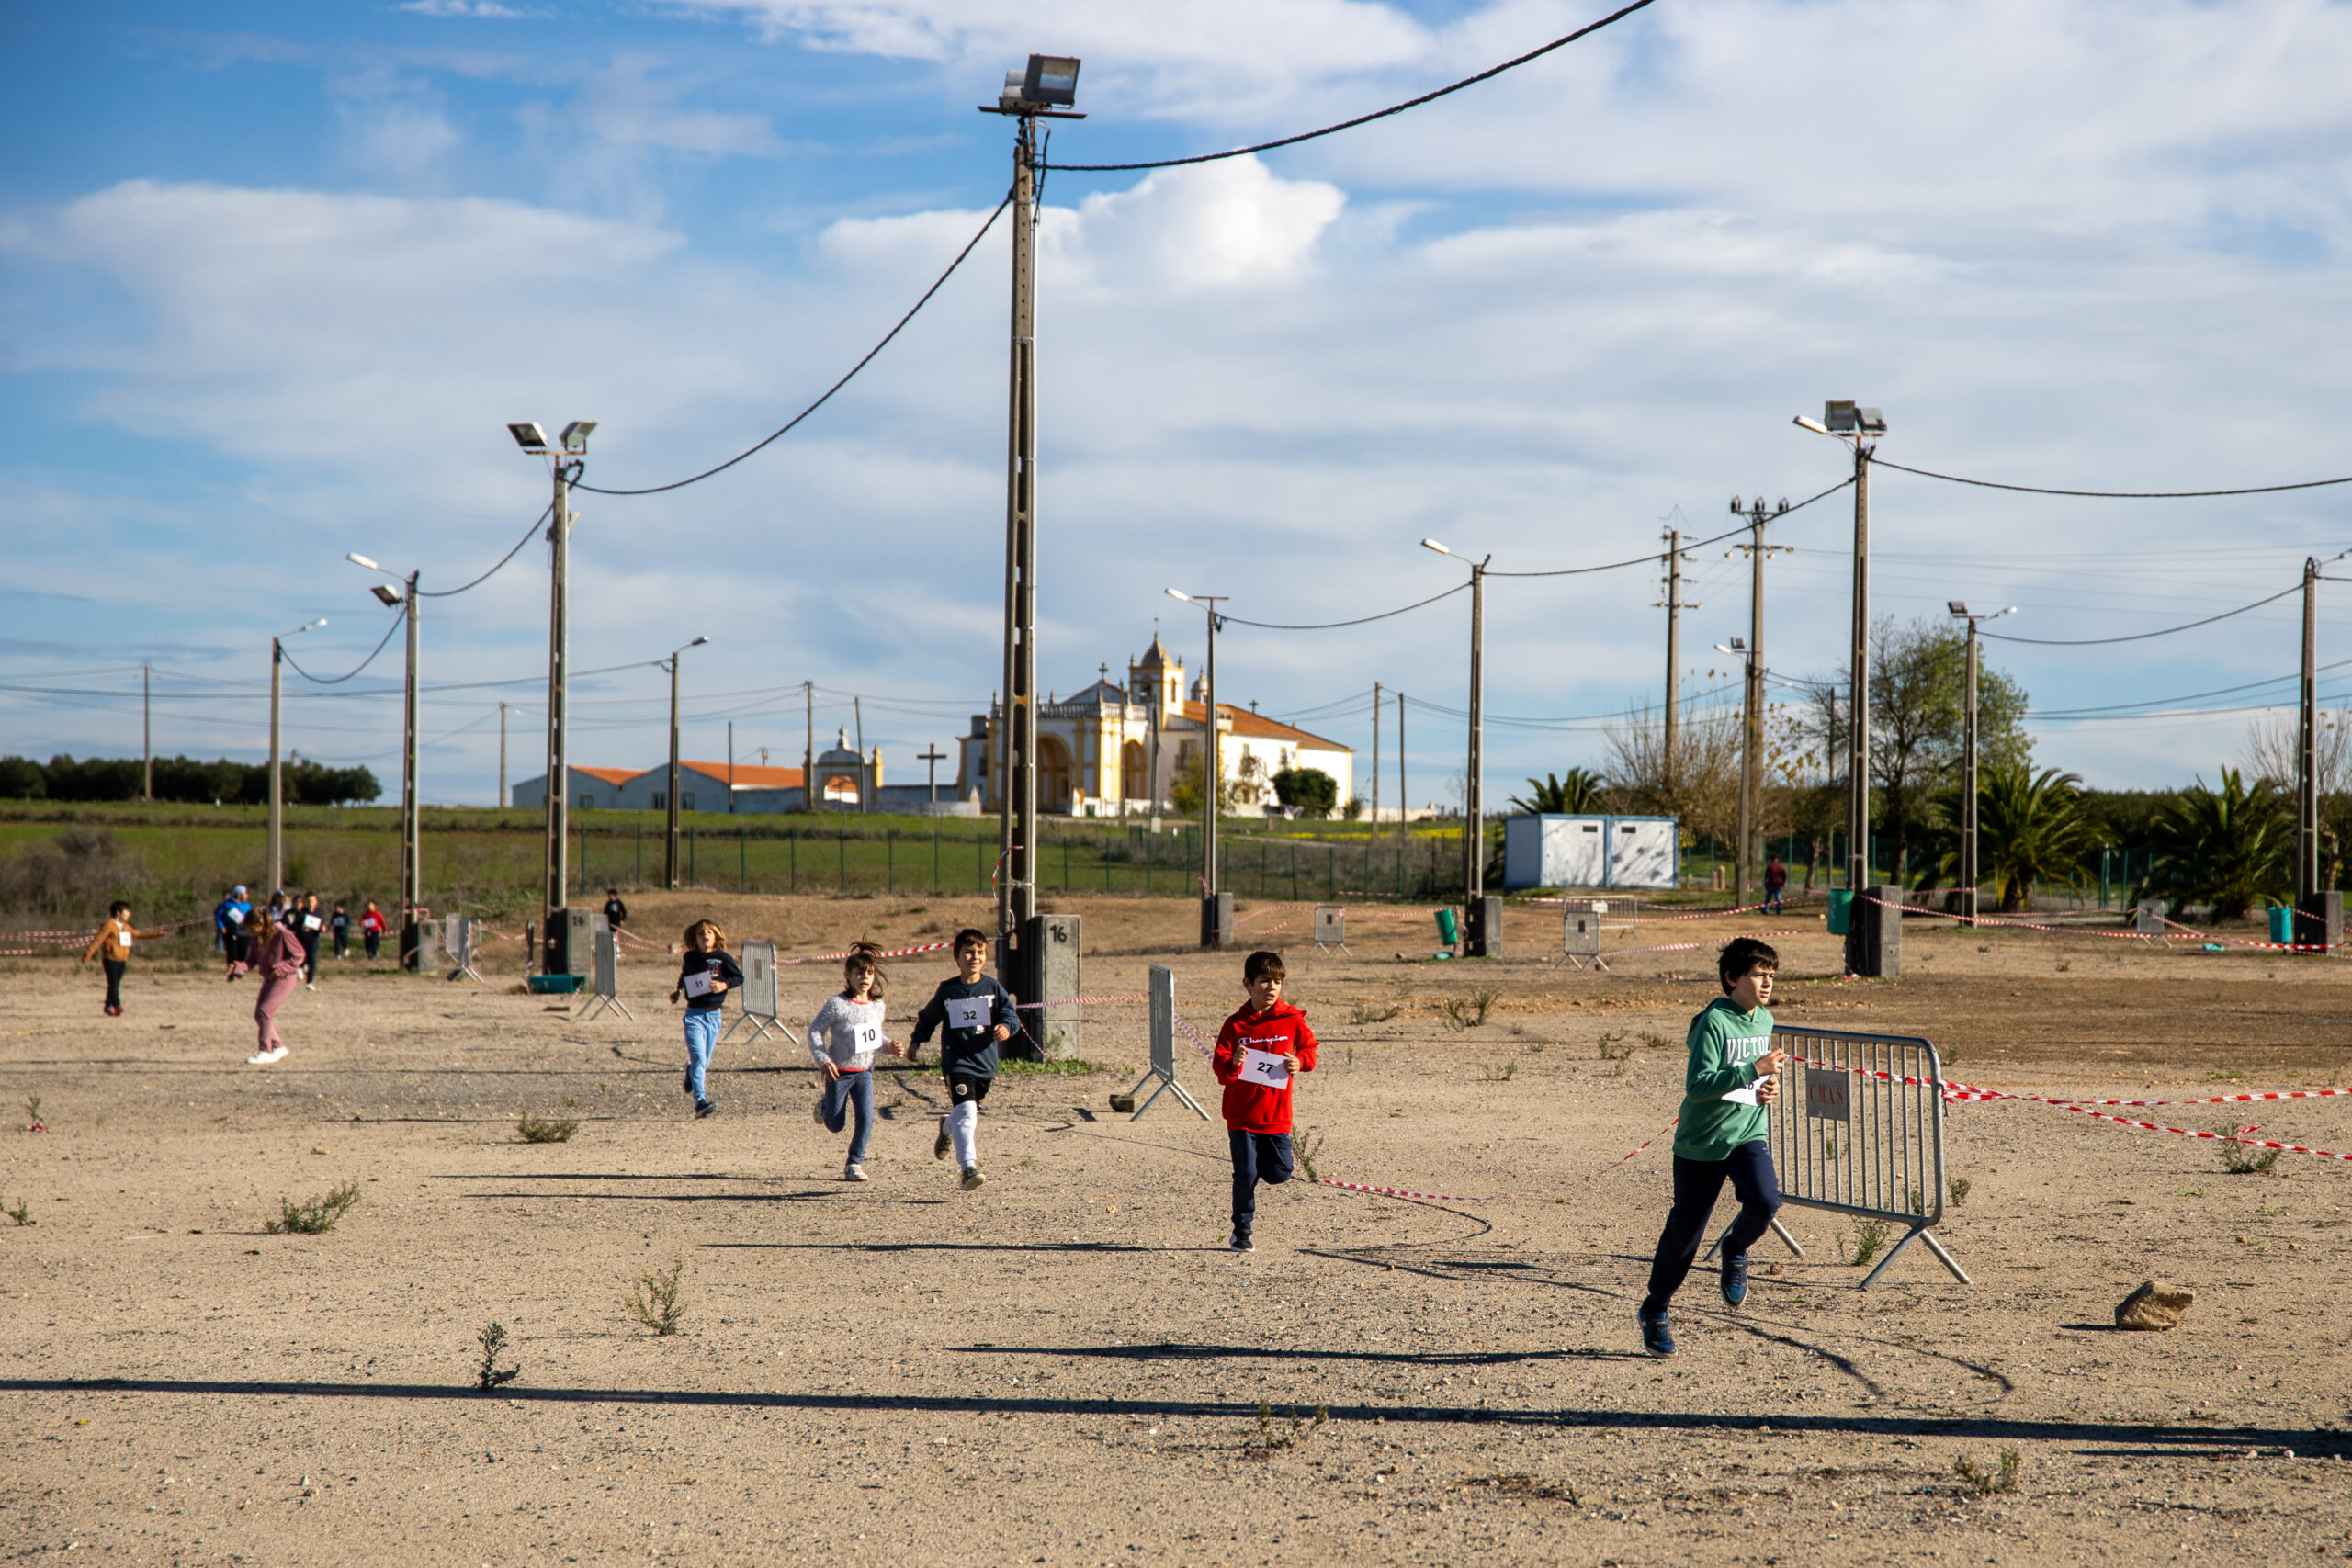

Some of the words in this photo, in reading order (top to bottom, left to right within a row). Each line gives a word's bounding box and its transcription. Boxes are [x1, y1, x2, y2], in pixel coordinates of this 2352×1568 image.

[1050, 924, 1067, 942] 16
[694, 980, 703, 988] 31
[963, 1010, 978, 1021] 32
[862, 1028, 876, 1043] 10
[1238, 1034, 1289, 1046] Champion
[1257, 1061, 1274, 1073] 27
